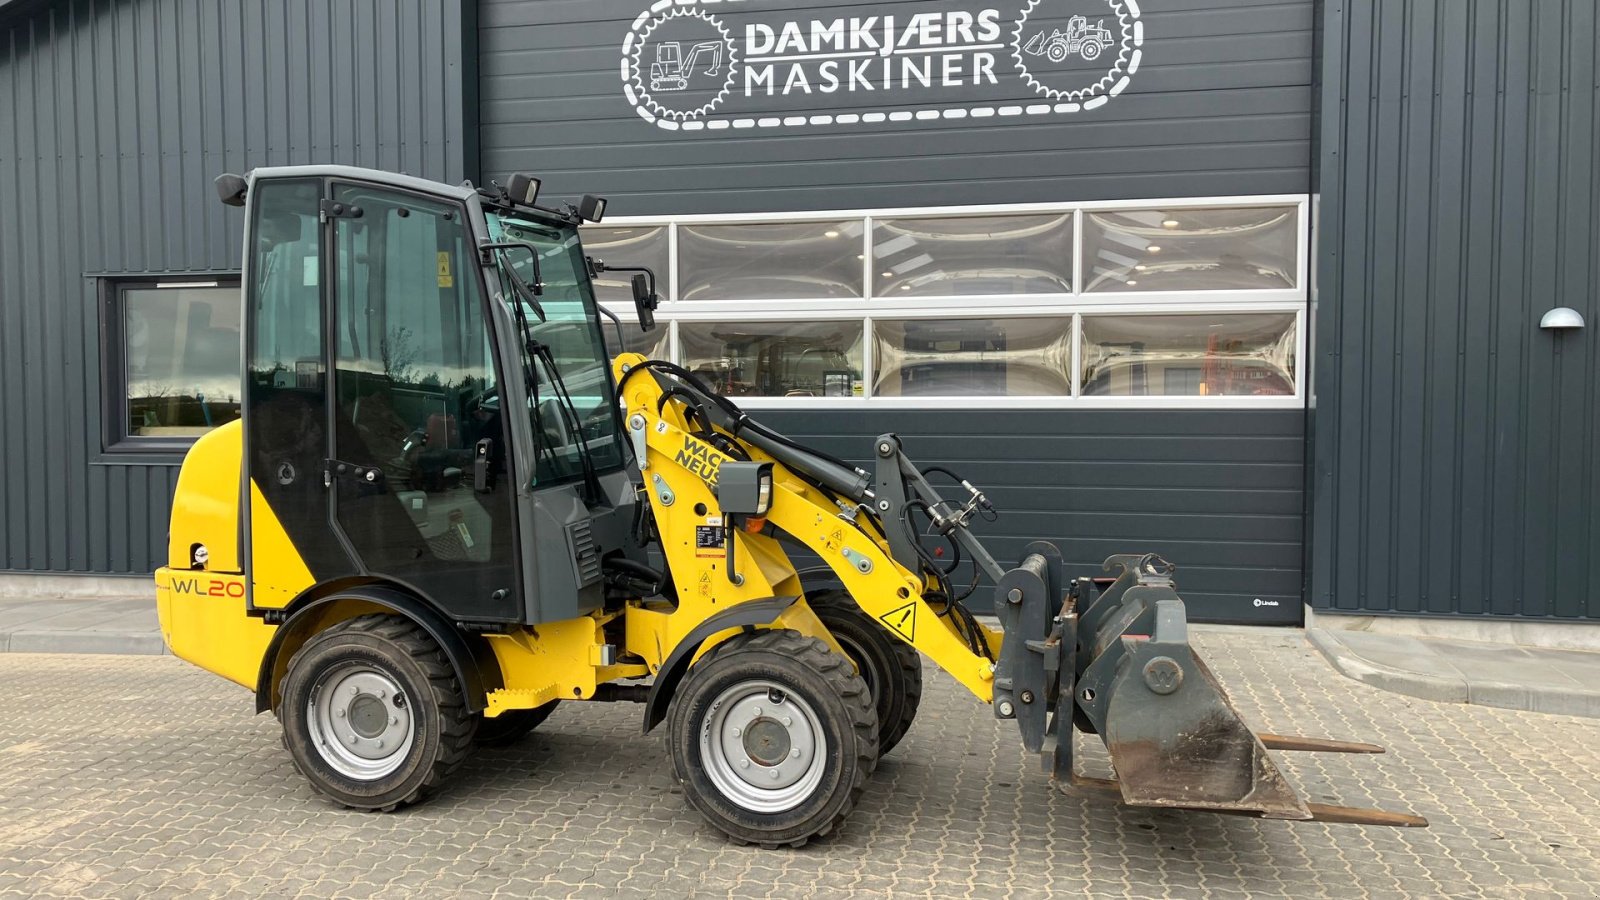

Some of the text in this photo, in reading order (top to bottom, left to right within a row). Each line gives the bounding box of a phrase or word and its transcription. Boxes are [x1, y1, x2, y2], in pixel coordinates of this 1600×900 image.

[745, 9, 1001, 57] DAMKJÆRS
[744, 53, 1000, 97] MASKINER
[172, 577, 245, 598] WL20
